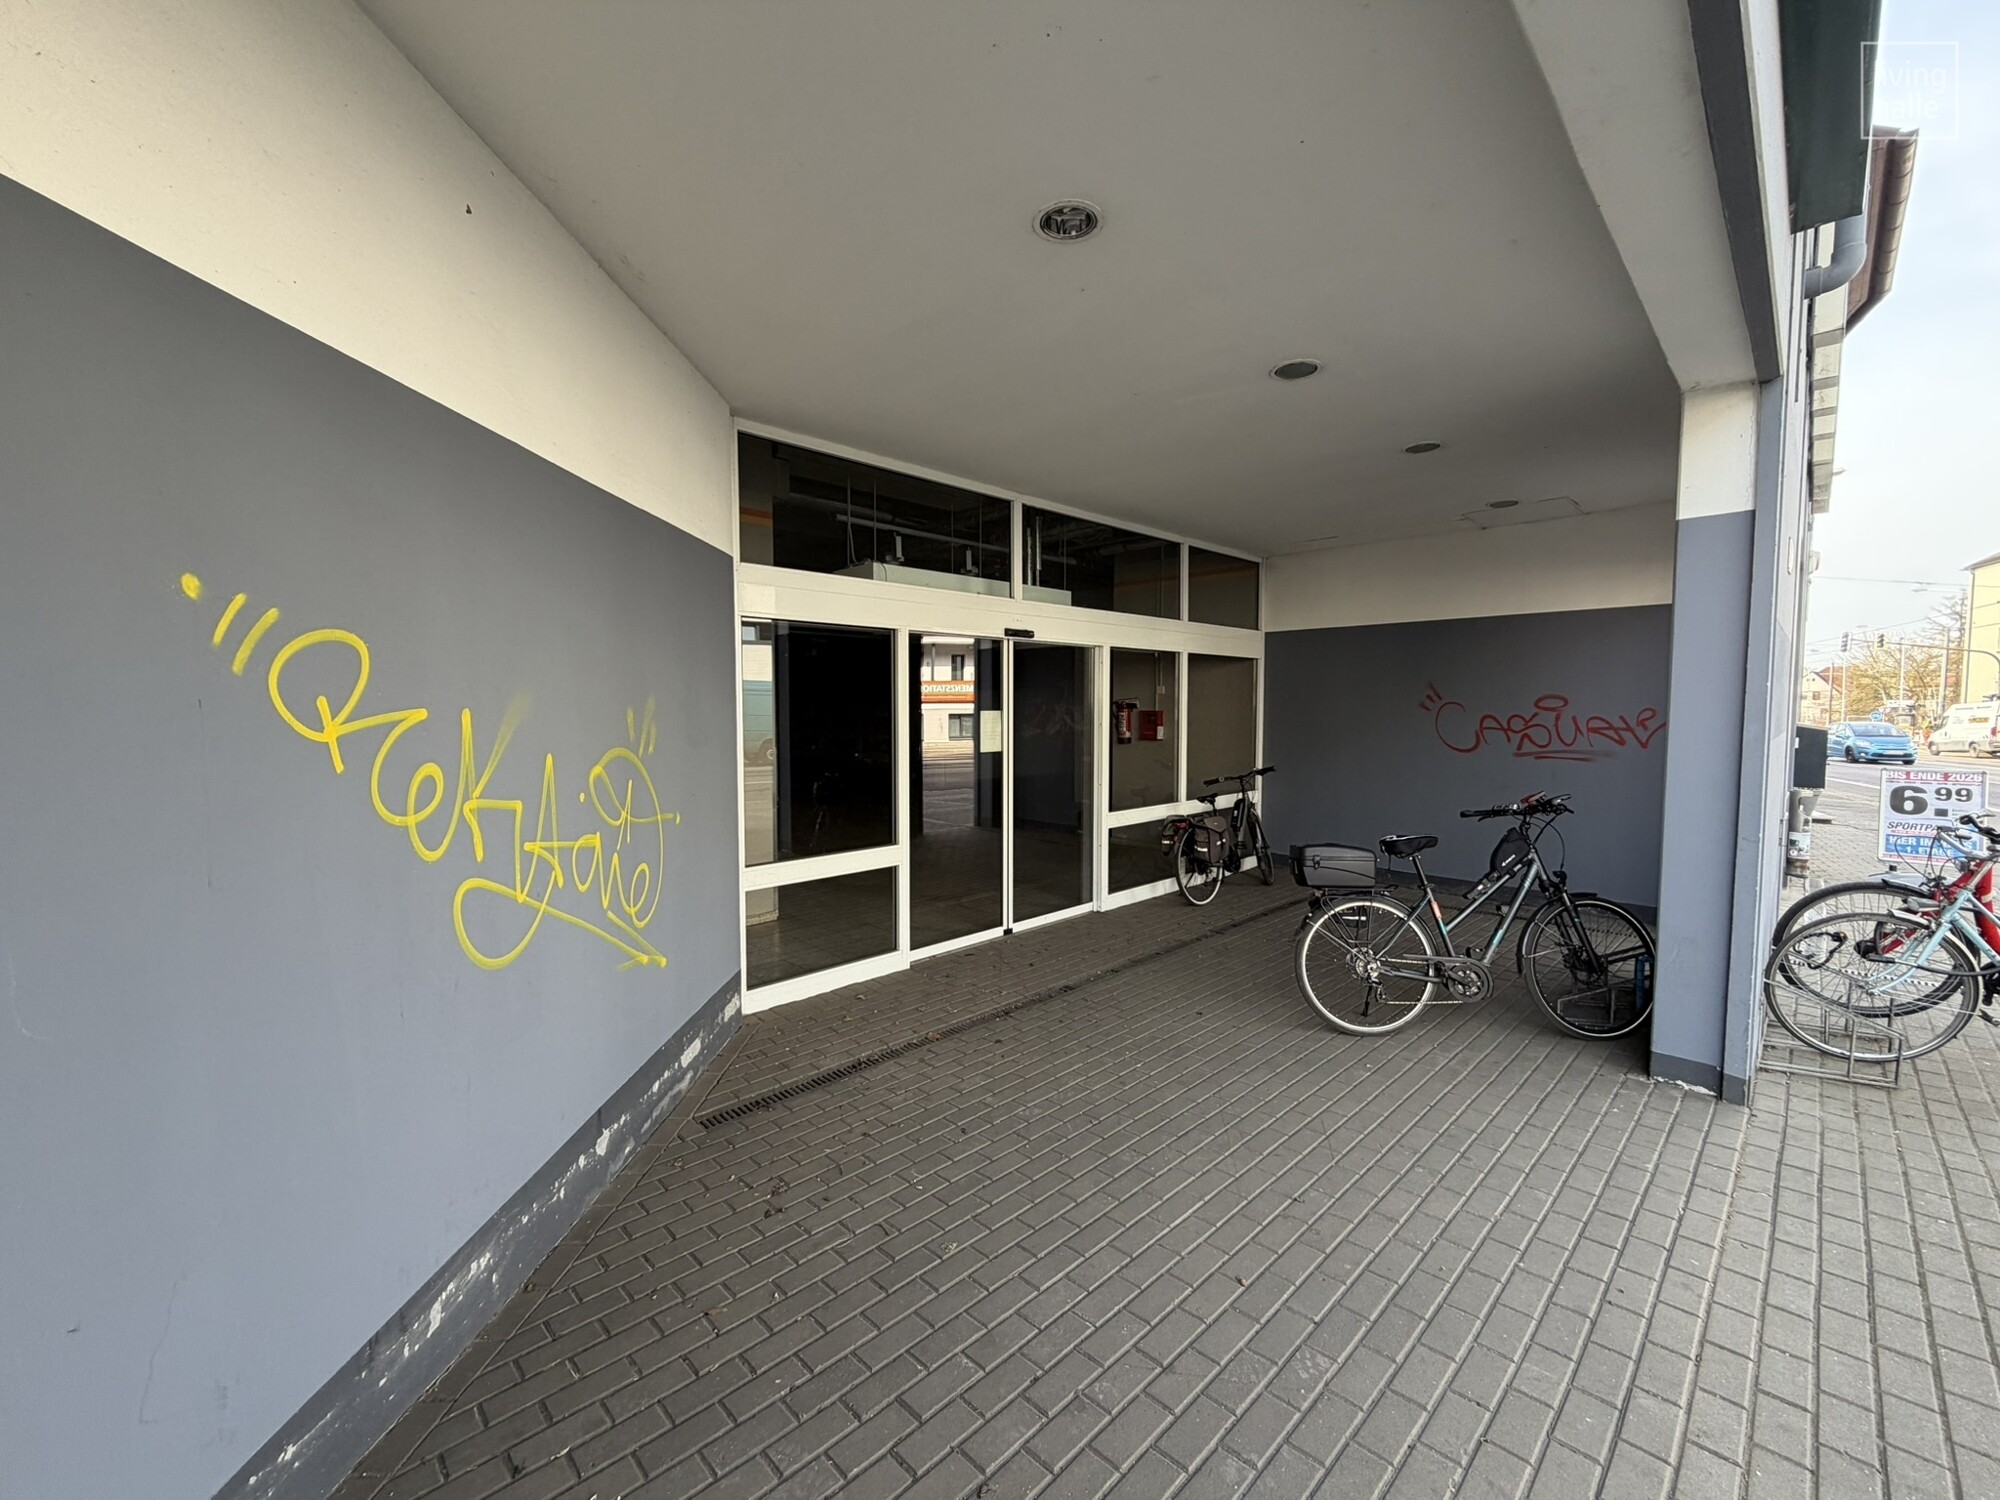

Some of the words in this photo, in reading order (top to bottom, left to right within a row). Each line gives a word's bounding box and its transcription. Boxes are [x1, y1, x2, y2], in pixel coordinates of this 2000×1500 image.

[1887, 771, 1907, 780] BIS
[1909, 772, 1944, 781] ENDE
[1947, 773, 1983, 782] 2026
[1889, 785, 1974, 817] 6.99
[1887, 821, 1939, 832] SPORTPA
[1889, 835, 1917, 846] HIER
[1906, 846, 1916, 854] 1.
